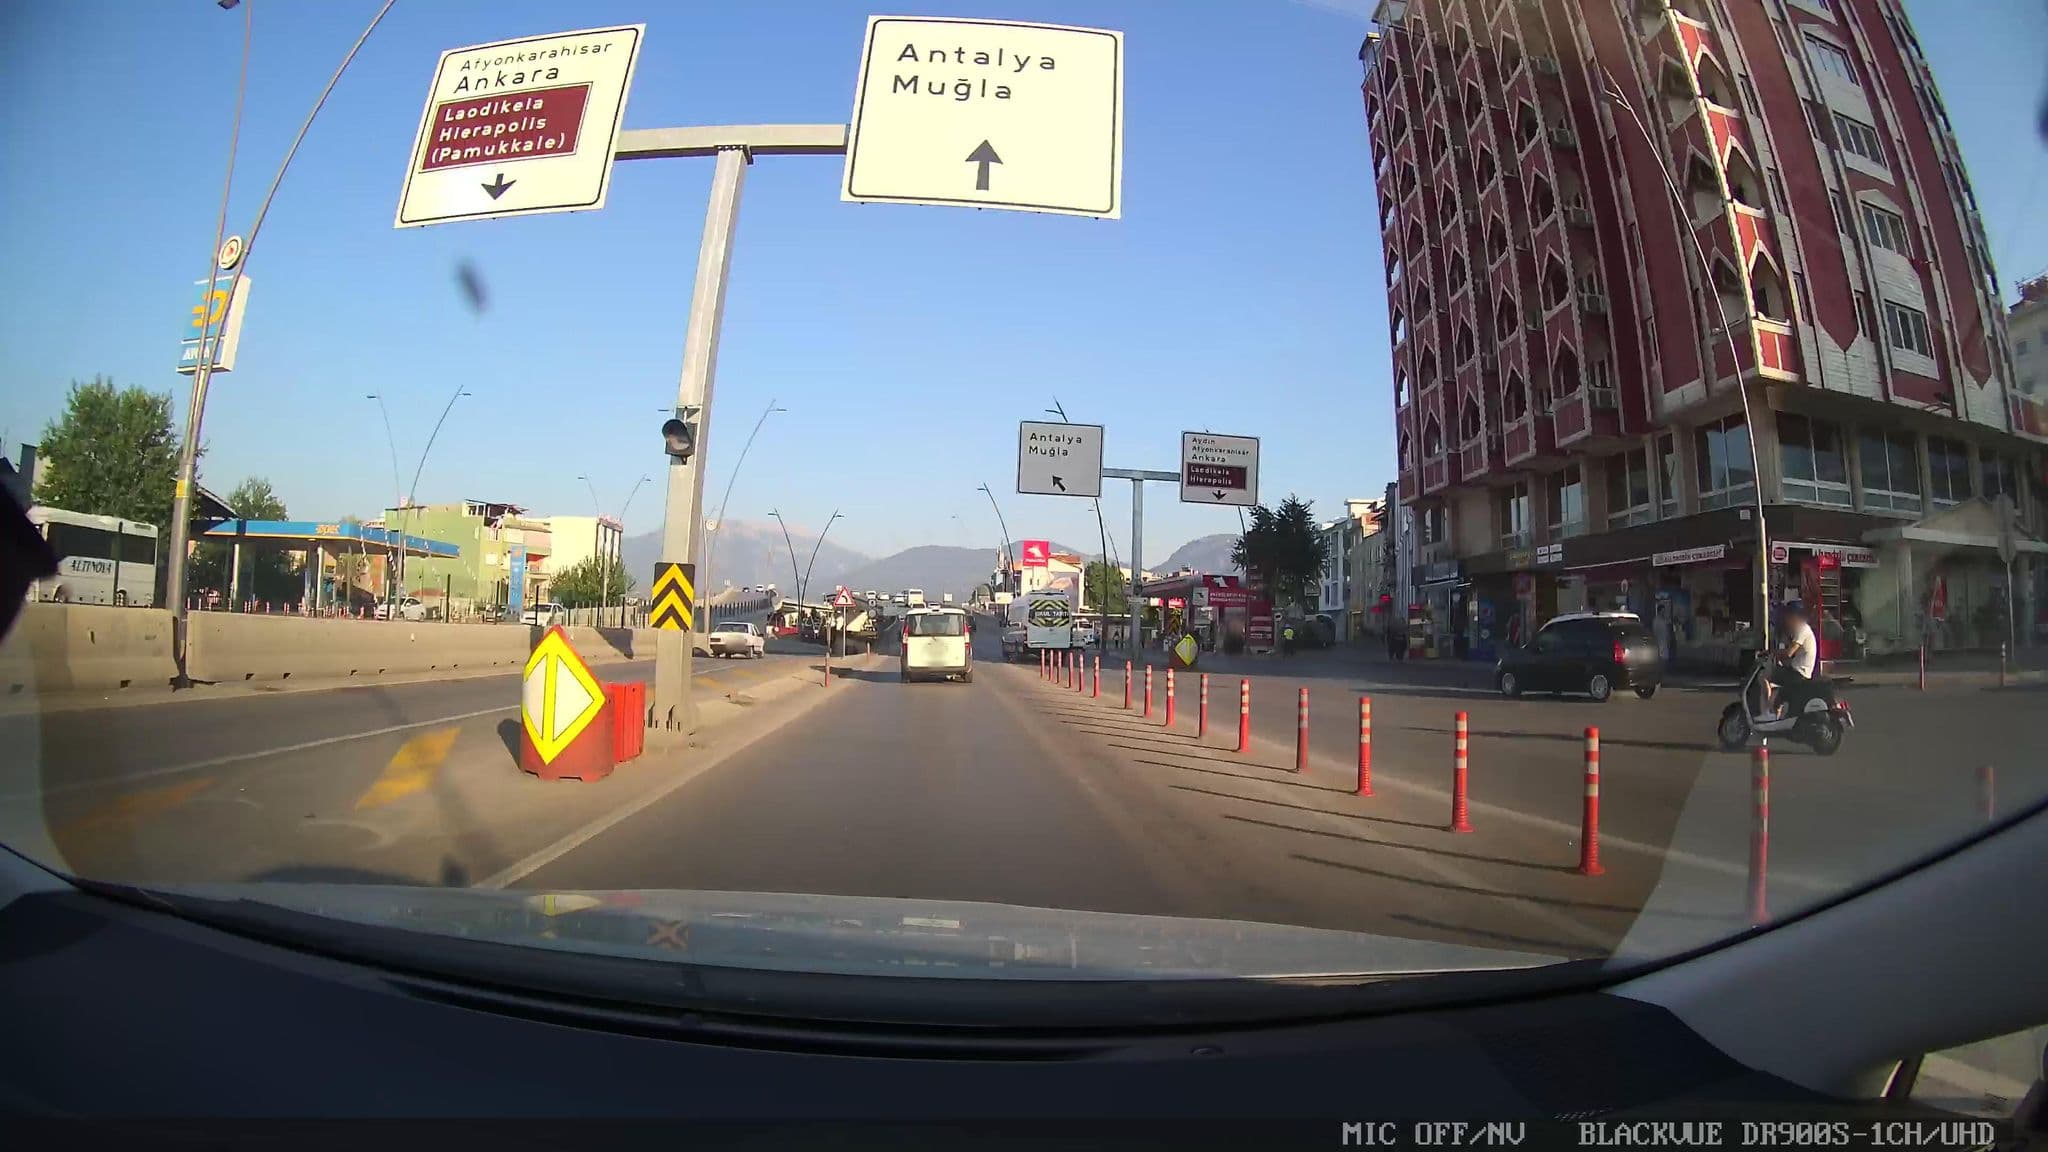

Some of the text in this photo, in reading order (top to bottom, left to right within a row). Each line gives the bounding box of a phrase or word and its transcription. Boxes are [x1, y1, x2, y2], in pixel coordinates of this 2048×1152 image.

[460, 42, 613, 72] Afyonkarahisar
[897, 43, 1056, 73] Antalya
[454, 67, 560, 94] Ankara
[892, 74, 1012, 101] Muğla
[444, 97, 545, 122] Laodikeia
[439, 117, 548, 142] Hierapolis
[431, 132, 565, 164] (Pamukkale)
[1029, 432, 1083, 445] Antalya
[1028, 446, 1069, 458] Muğla
[1191, 454, 1226, 464] Ankara
